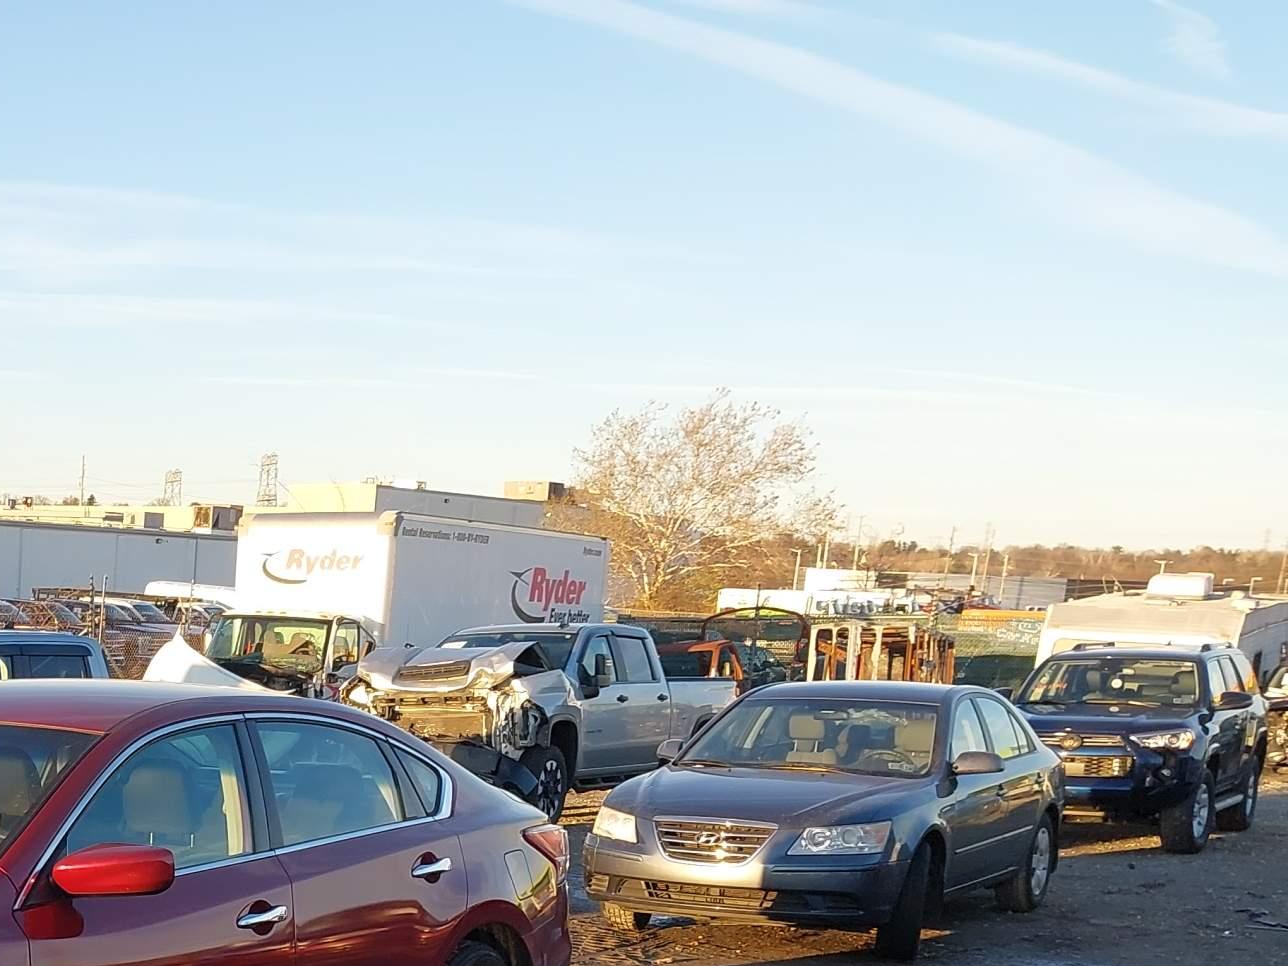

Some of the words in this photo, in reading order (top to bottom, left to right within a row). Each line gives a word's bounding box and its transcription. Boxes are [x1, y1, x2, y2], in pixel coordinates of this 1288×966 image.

[286, 548, 364, 575] Ryder
[528, 567, 586, 612] Ryder
[548, 607, 567, 624] Ever
[567, 609, 590, 624] better
